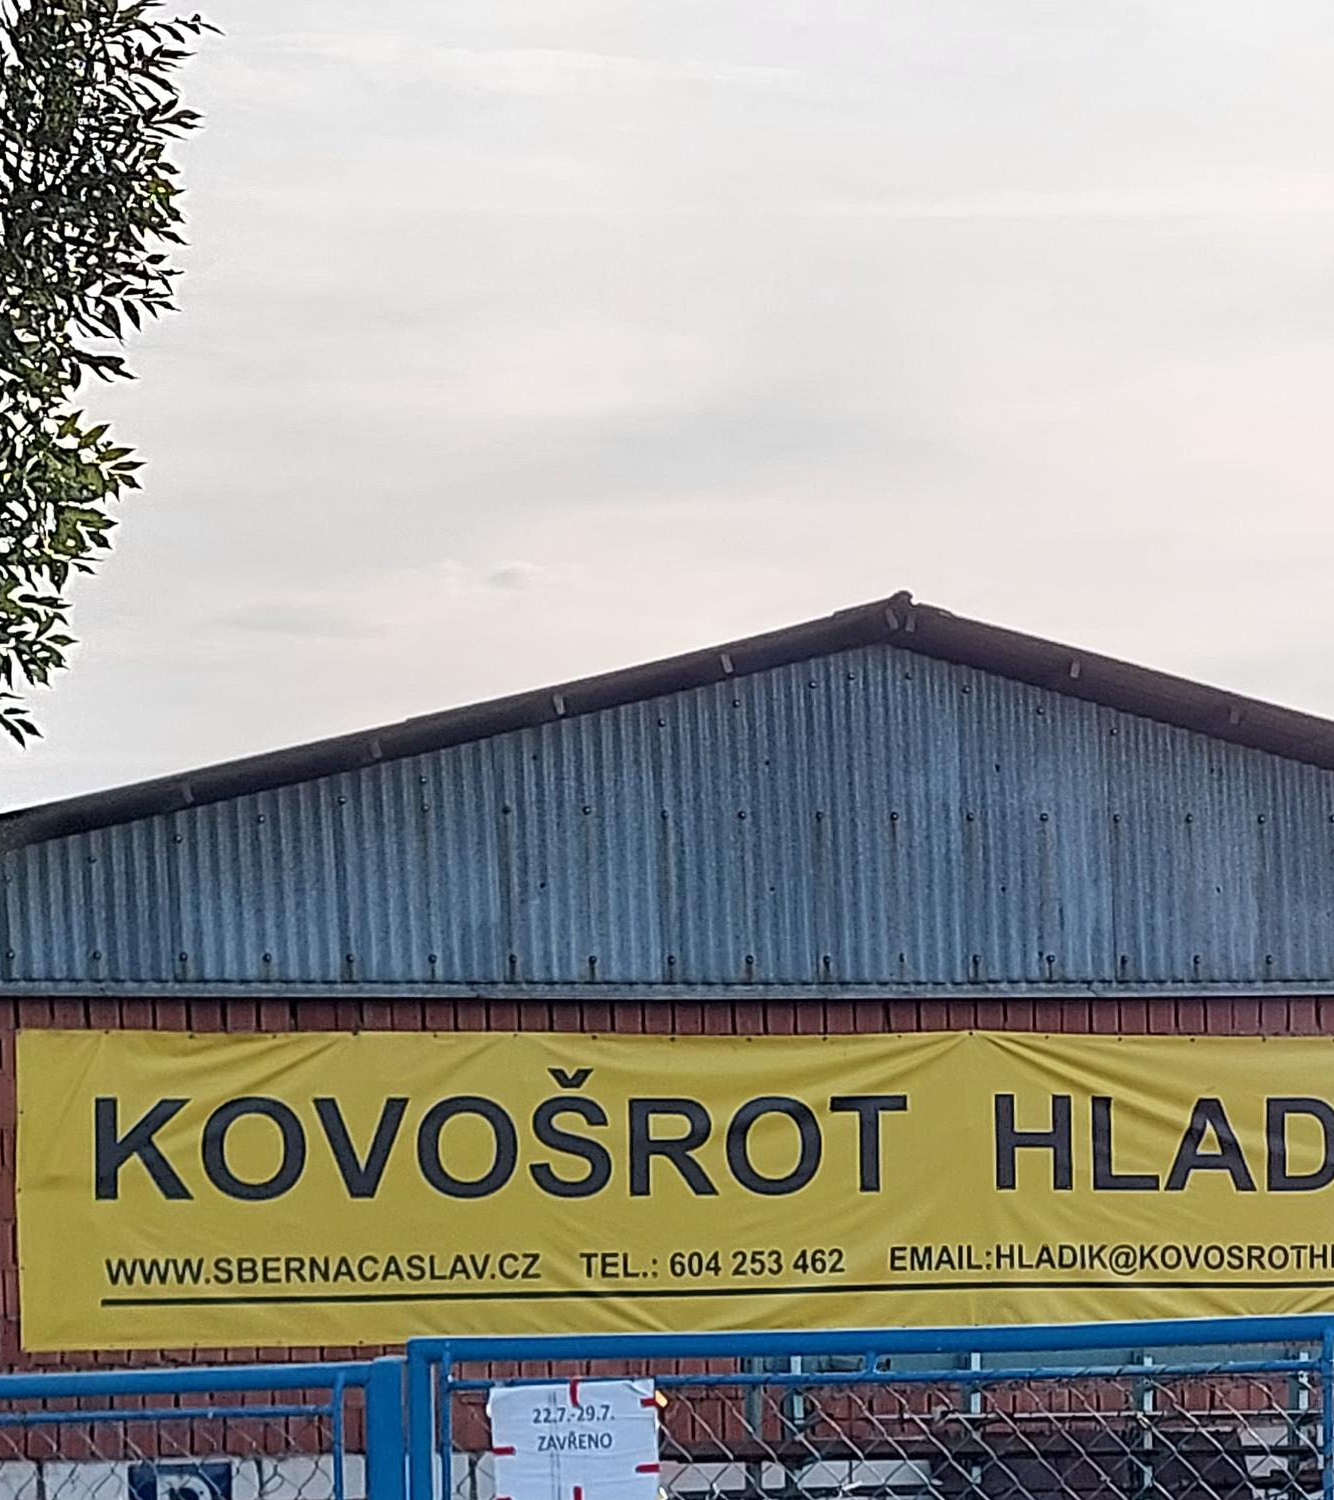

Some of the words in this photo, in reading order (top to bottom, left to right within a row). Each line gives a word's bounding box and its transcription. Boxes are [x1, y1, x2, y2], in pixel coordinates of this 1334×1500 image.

[94, 1067, 907, 1201] KOVOŠROT
[105, 1252, 541, 1286] WWW.SBERNACASLAV.CZ
[579, 1251, 658, 1279] TEL.:
[669, 1250, 721, 1278] 604
[731, 1249, 783, 1276] 253
[792, 1248, 845, 1275] 462
[537, 1431, 613, 1452] ZAVŘENO
